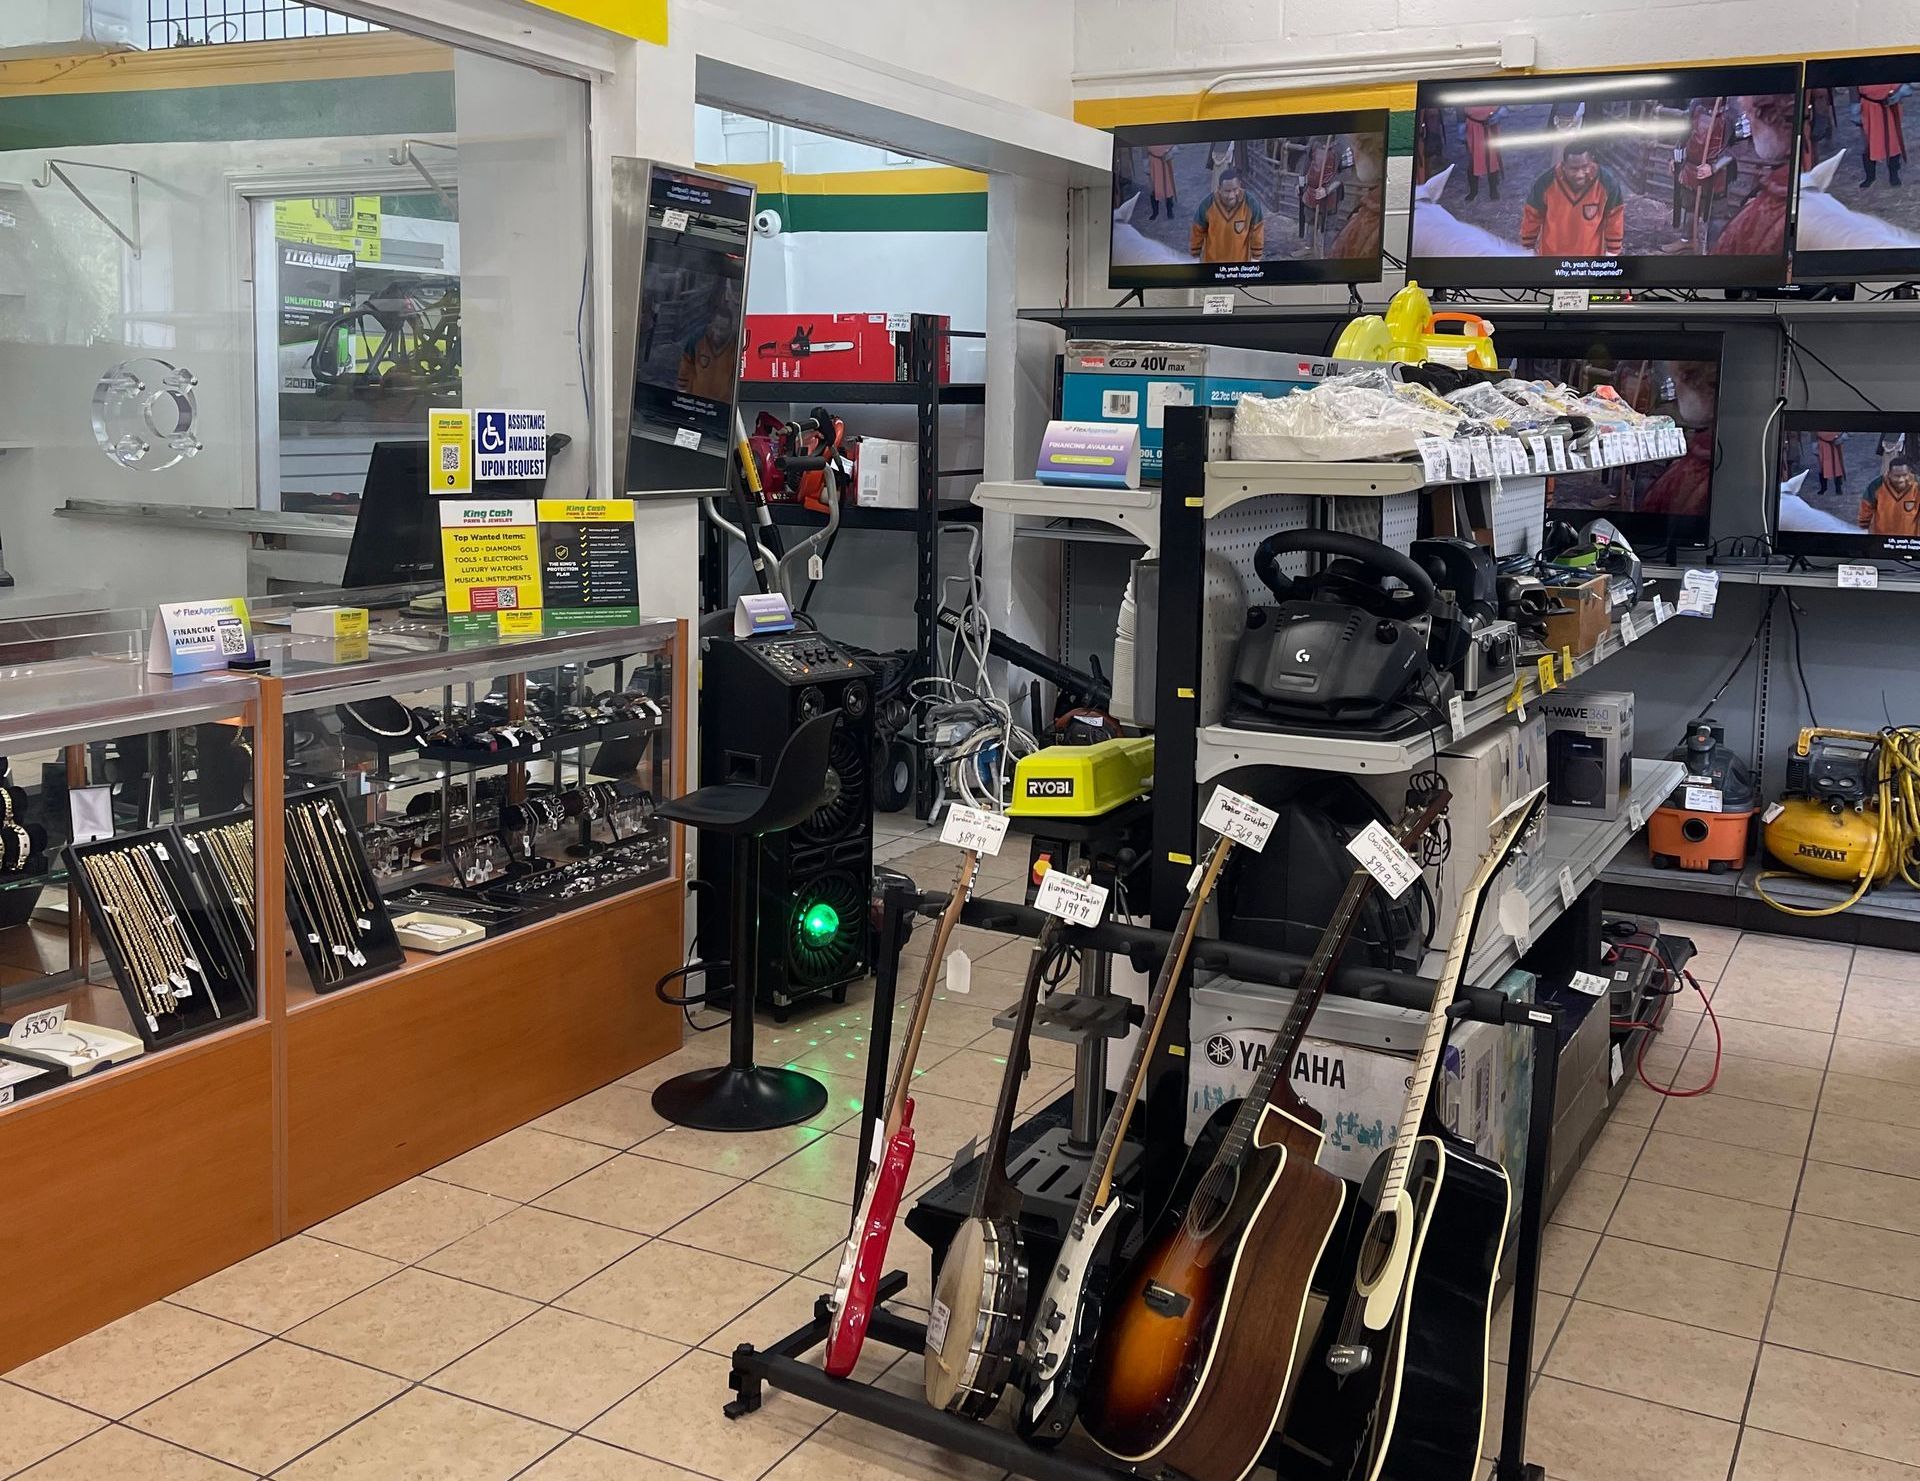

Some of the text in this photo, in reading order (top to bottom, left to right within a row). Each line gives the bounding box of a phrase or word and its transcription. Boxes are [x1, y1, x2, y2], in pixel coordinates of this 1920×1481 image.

[1591, 261, 1617, 269] (laughs)
[1588, 269, 1623, 277] happened?
[285, 296, 322, 308] UNLIMITED
[1112, 359, 1134, 367] XGT
[1141, 357, 1167, 370] 40V
[1168, 364, 1185, 372] max
[508, 414, 545, 429] ASSISTANCE
[508, 436, 545, 452] AVAILABLE
[1049, 441, 1124, 451] FINANCING AVAILABLE
[481, 460, 544, 476] UPON REQUEST
[464, 509, 513, 519] King Cash
[566, 505, 585, 513] King
[454, 534, 468, 542] Top
[483, 555, 528, 563] ELECTRONICS
[486, 574, 531, 582] INSTRUMENTS
[184, 605, 233, 616] FlexApproved
[173, 626, 216, 636] FINANCING
[175, 635, 215, 646] AVAILABLE
[1028, 781, 1070, 794] RYOBI
[1239, 1040, 1346, 1090] YAAHA
